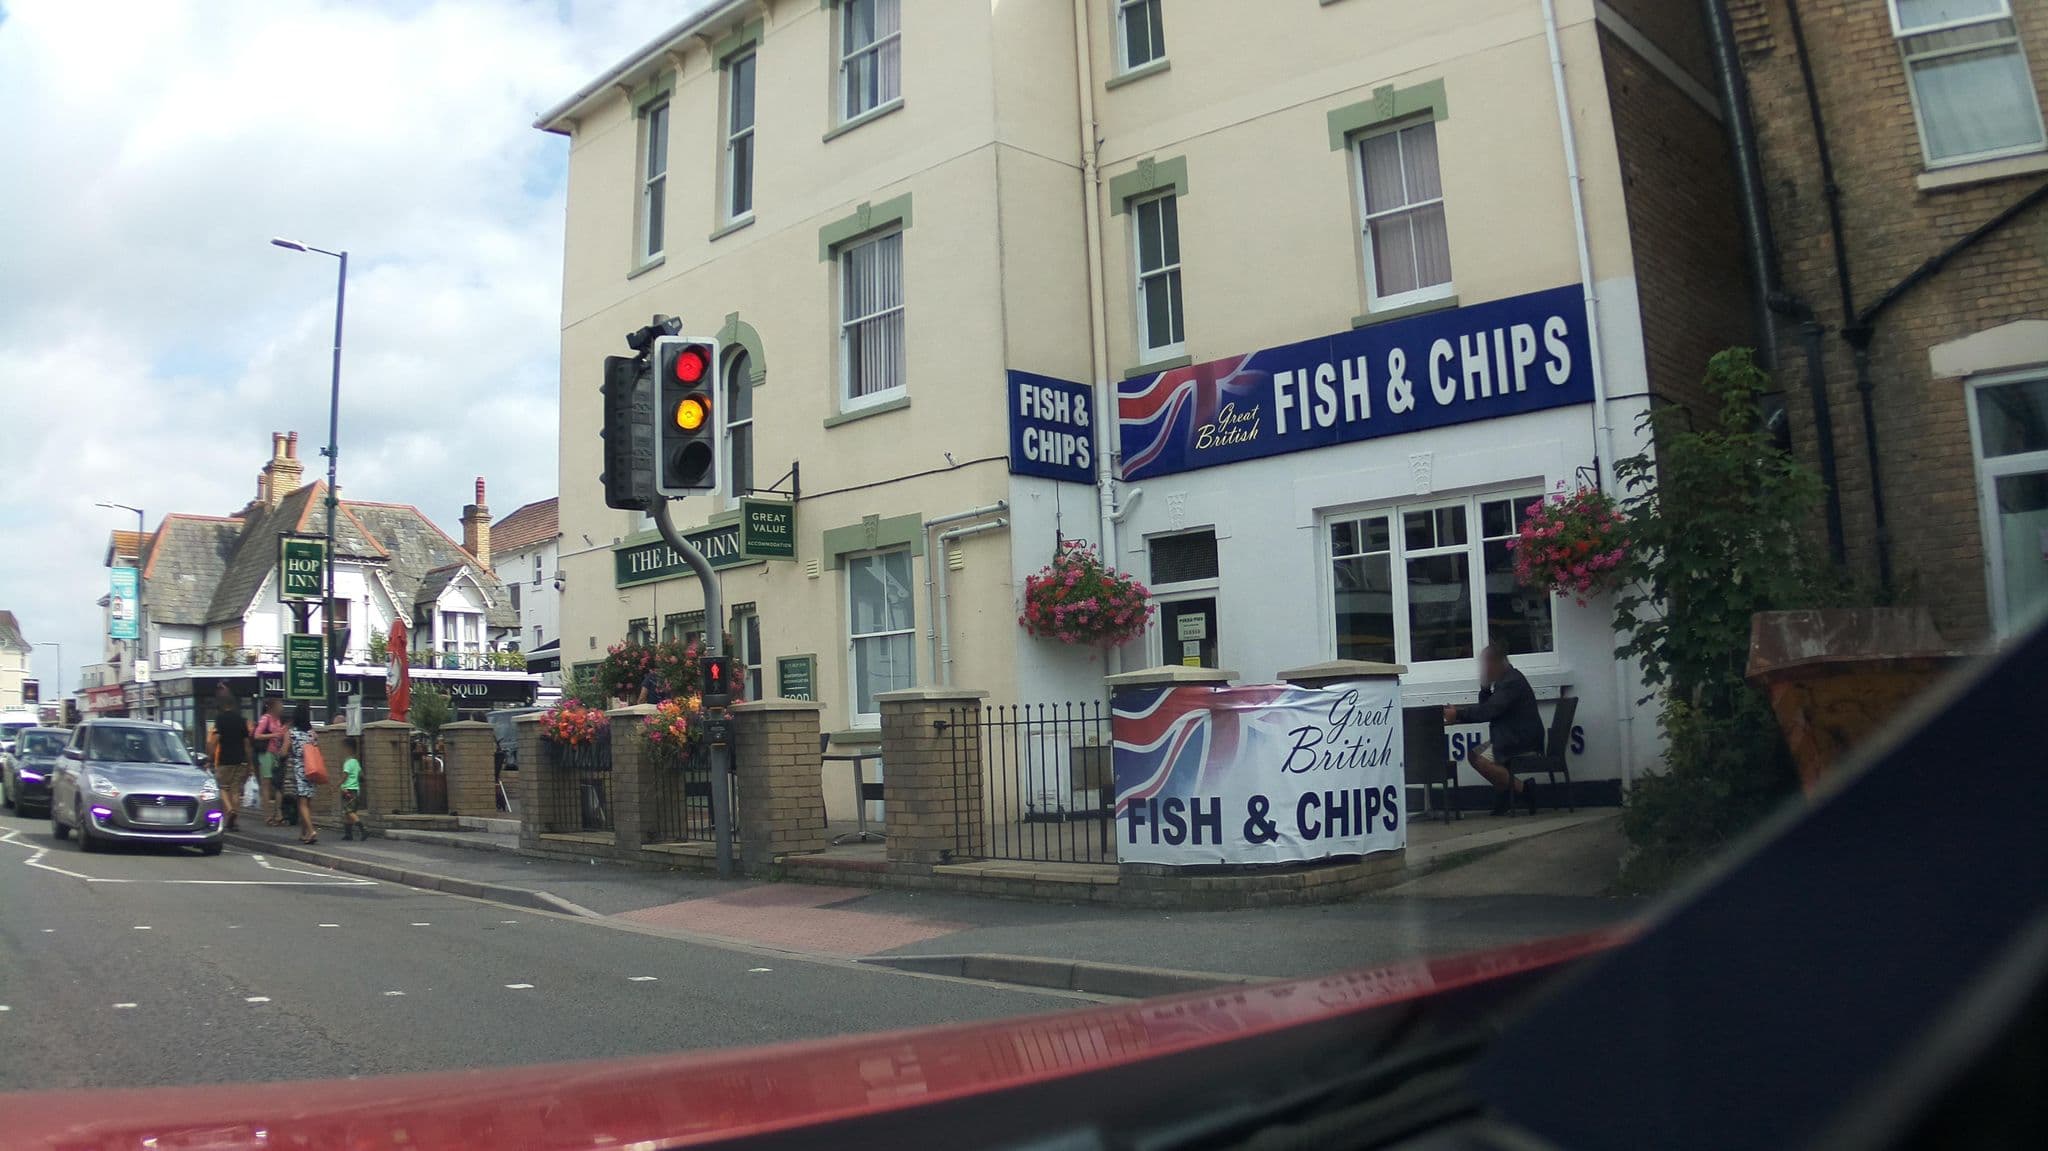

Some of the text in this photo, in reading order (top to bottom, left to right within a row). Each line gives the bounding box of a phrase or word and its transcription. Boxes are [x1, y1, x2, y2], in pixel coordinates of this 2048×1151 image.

[1273, 315, 1572, 435] FISH & CHIPS
[1019, 383, 1090, 428] FISH &
[1218, 402, 1260, 427] Great
[1022, 427, 1091, 470] CHIPS
[1195, 417, 1259, 450] British
[751, 512, 786, 523] GREAT
[752, 524, 787, 534] VALUE
[288, 558, 320, 573] HOP
[628, 548, 663, 573] THE
[706, 532, 739, 559] INN
[288, 574, 320, 587] INN
[452, 684, 488, 698] SQUID
[1327, 689, 1394, 745] Great
[1281, 726, 1394, 774] British
[1127, 784, 1399, 845] FISH & CHIPS
